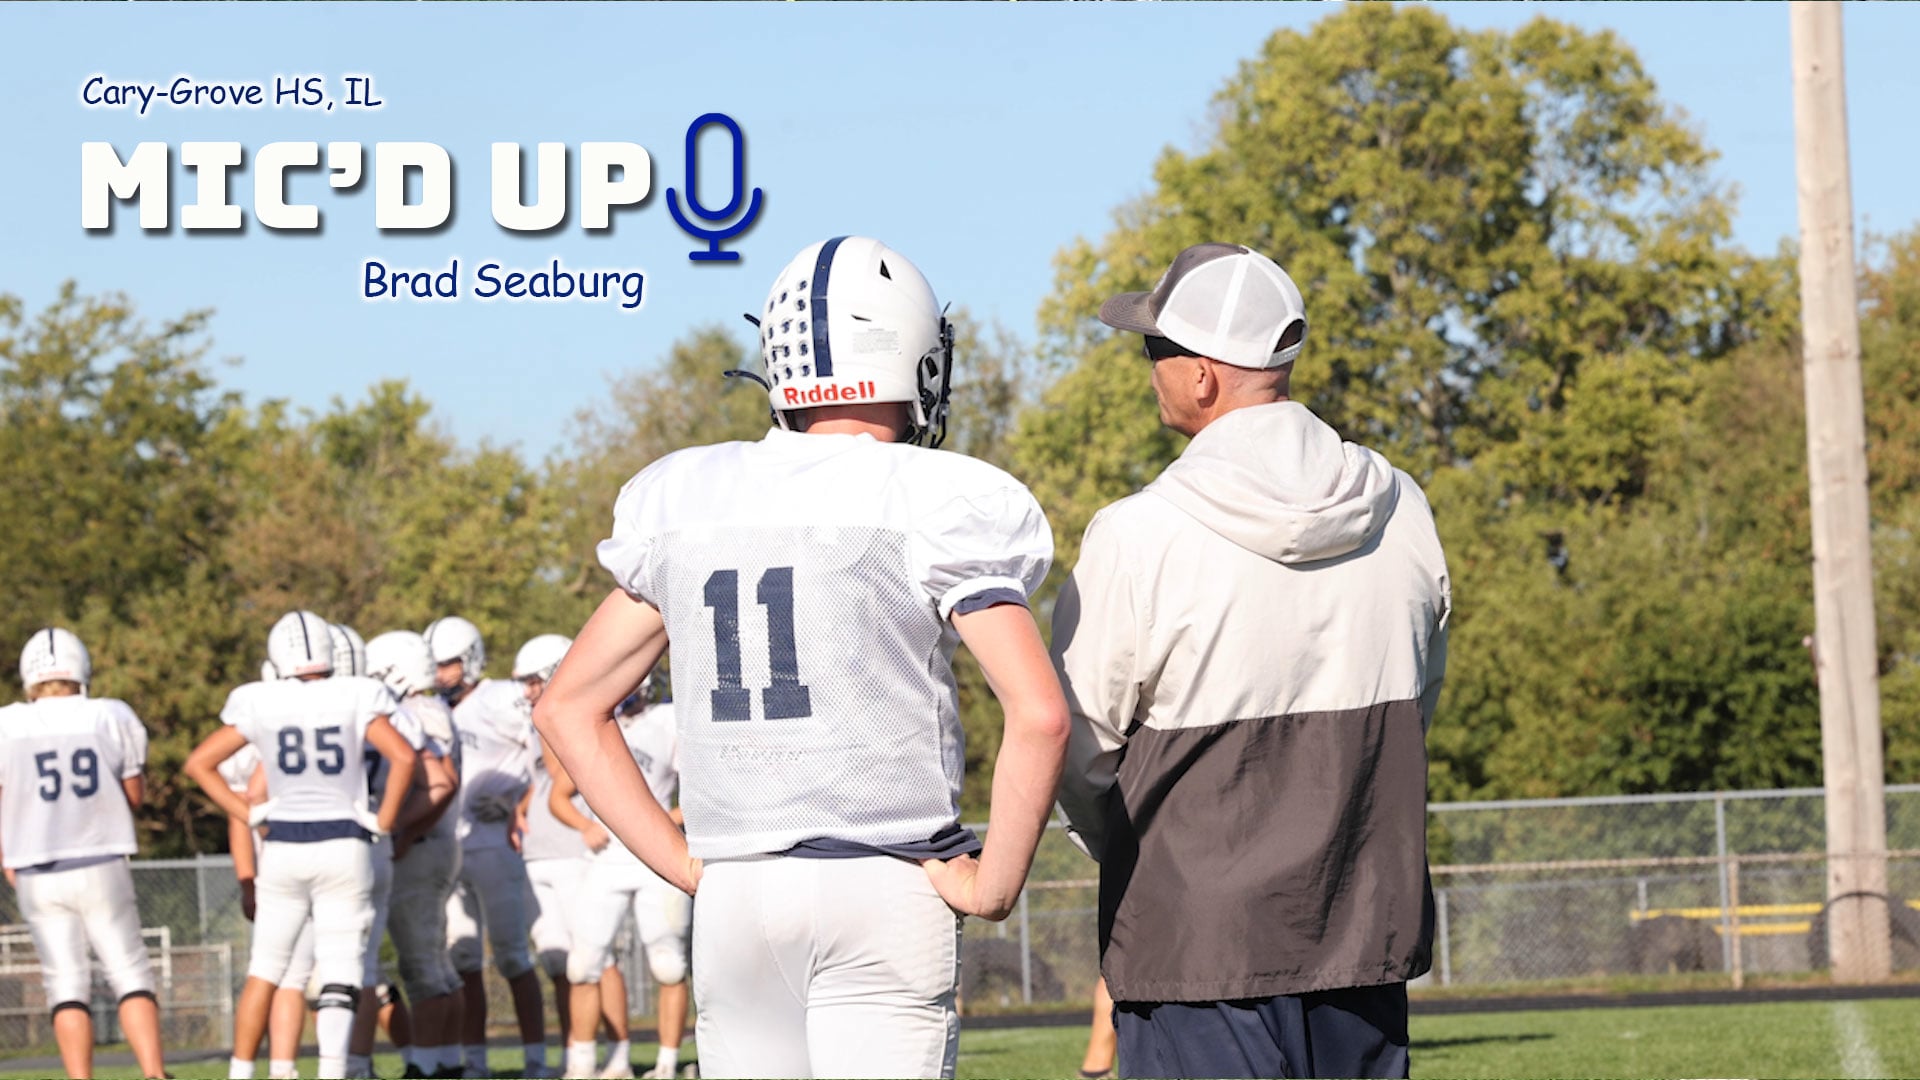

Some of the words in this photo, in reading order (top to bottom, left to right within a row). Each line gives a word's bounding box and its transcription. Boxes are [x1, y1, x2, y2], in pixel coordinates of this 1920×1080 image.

[783, 380, 876, 405] Riddell
[703, 566, 812, 722] 11
[35, 748, 99, 802] 59
[278, 726, 345, 775] 85
